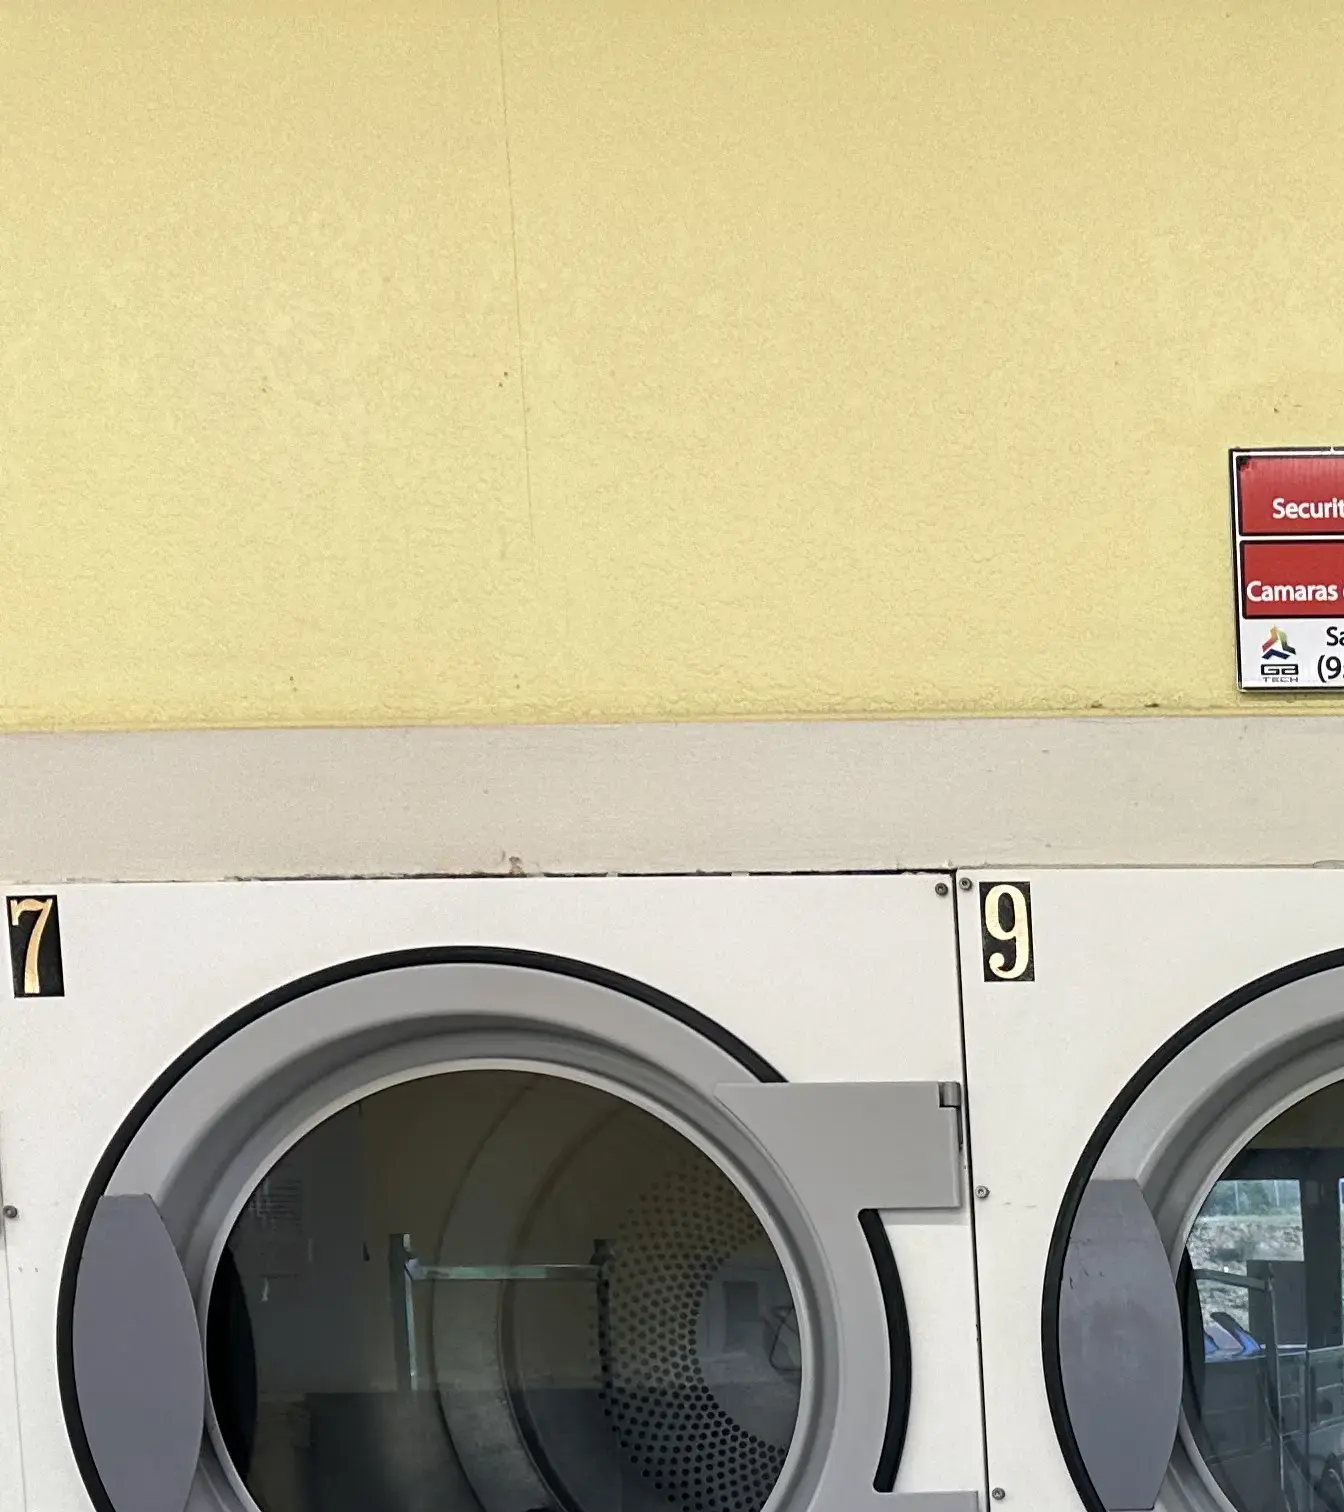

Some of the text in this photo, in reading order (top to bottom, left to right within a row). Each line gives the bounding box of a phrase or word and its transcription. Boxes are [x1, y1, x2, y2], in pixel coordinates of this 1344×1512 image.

[1246, 581, 1338, 602] Camaras
[10, 898, 54, 994] 7
[984, 884, 1030, 980] 9
